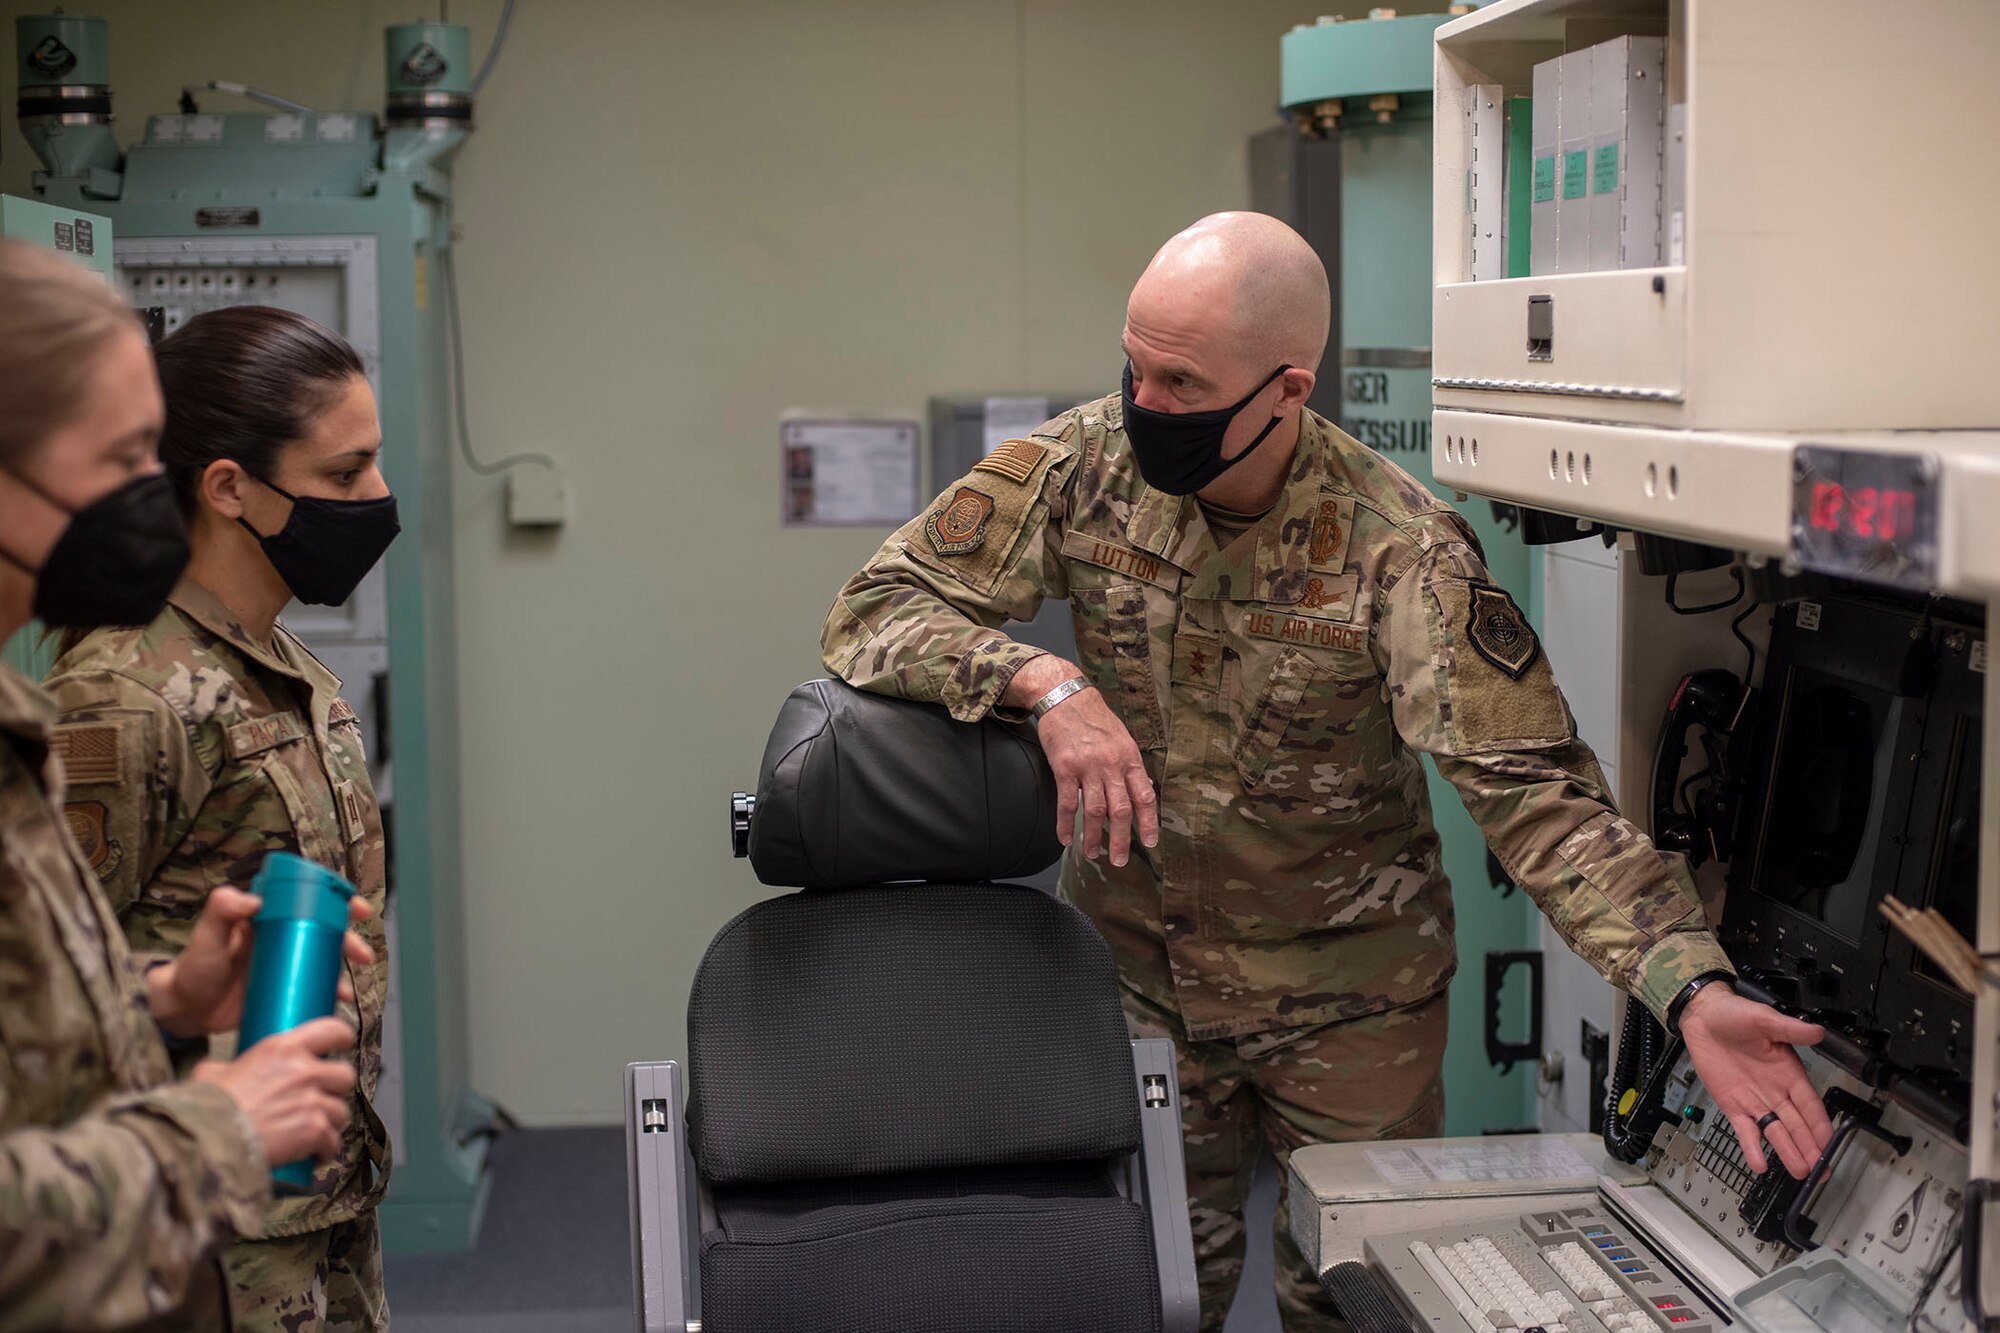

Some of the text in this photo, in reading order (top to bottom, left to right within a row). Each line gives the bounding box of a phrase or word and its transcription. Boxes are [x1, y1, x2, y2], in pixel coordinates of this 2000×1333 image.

[1092, 543, 1160, 580] LUTTON
[1281, 617, 1308, 641] AIR
[1311, 623, 1362, 651] FORCE
